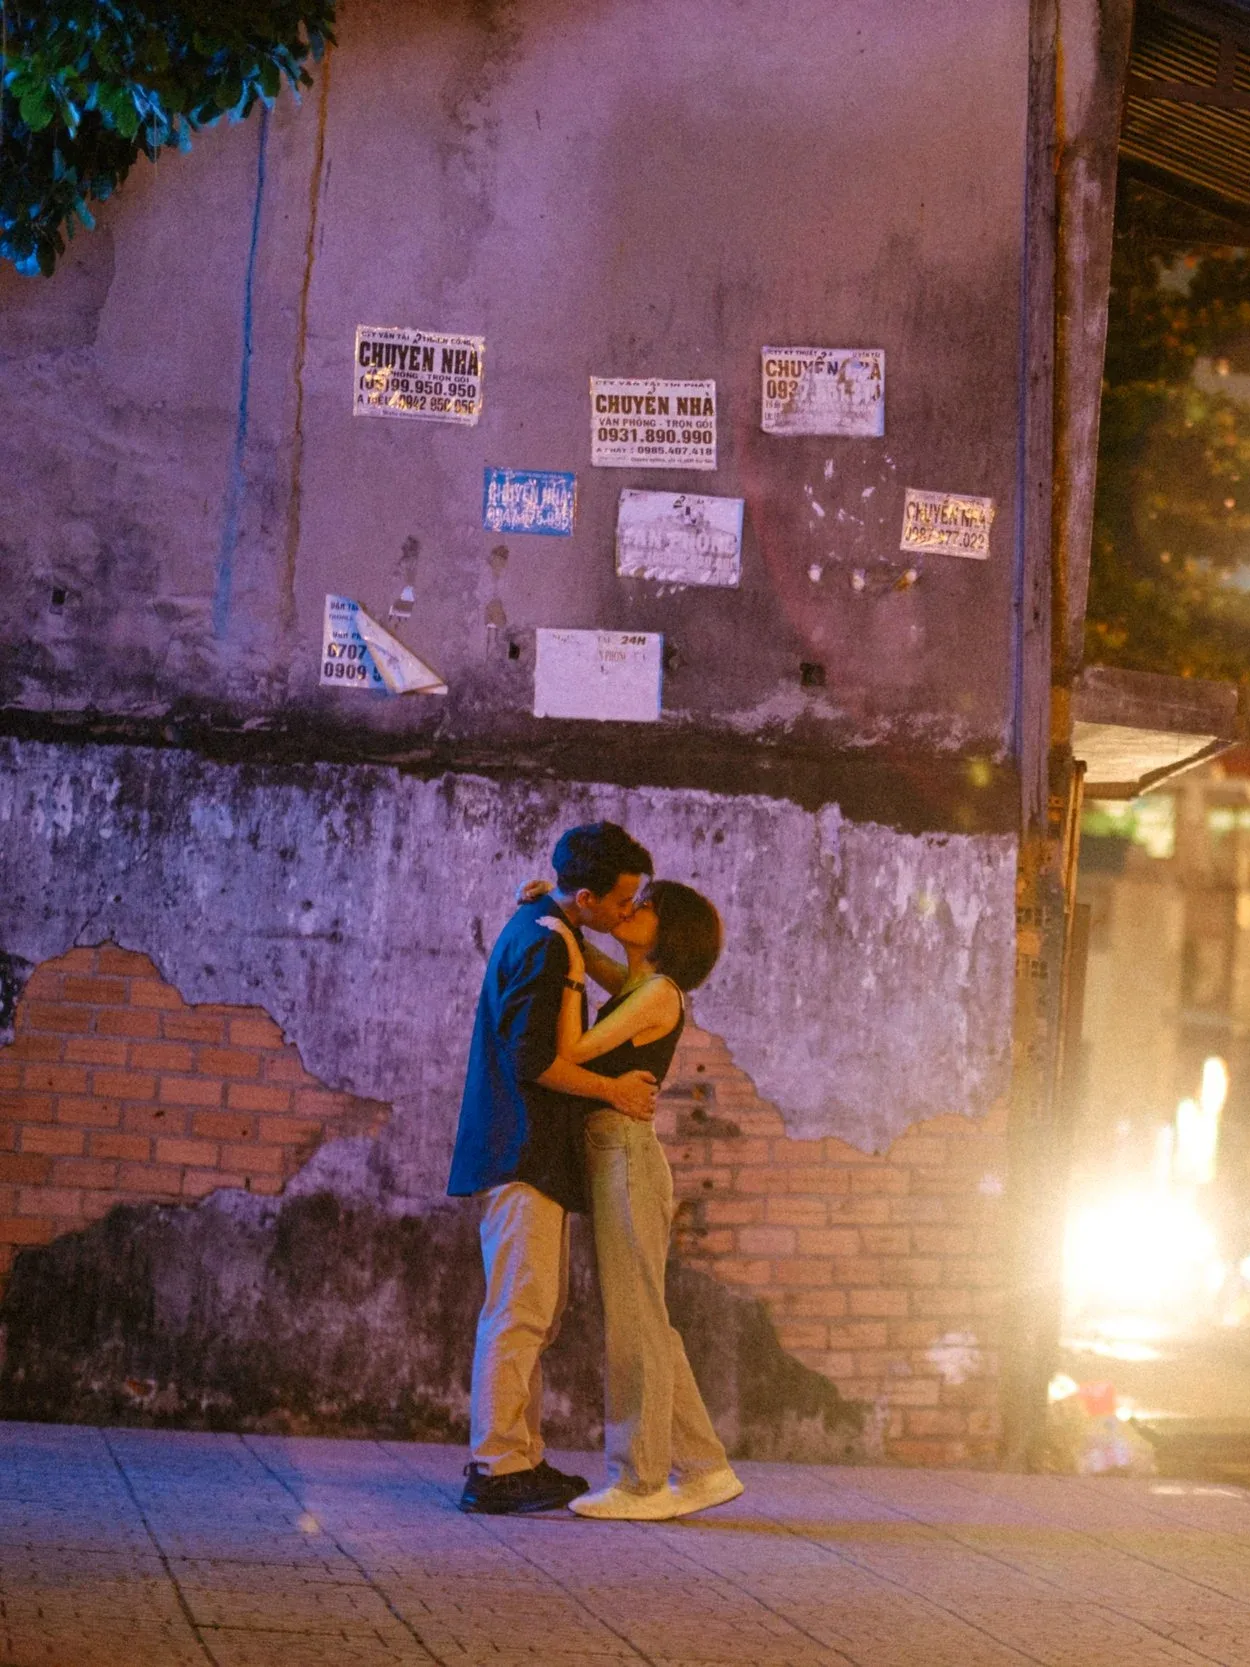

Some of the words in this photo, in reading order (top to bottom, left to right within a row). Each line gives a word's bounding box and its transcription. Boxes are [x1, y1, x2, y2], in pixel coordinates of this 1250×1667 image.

[595, 386, 670, 415] CHUYỂN
[676, 391, 714, 417] NHÀ
[598, 427, 713, 445] 0931.890.990
[620, 635, 645, 645] 24H
[324, 662, 367, 680] 0909
